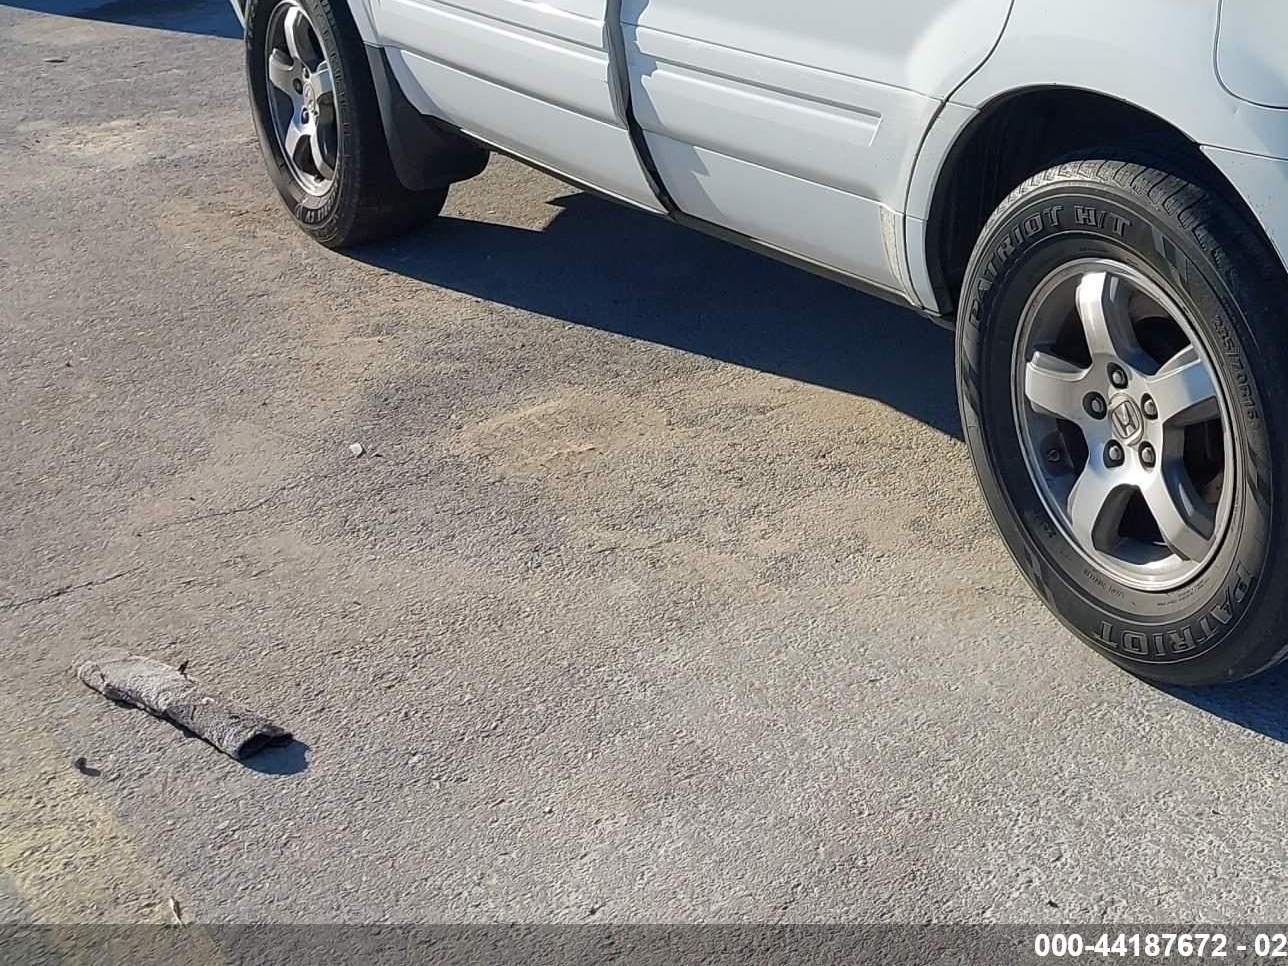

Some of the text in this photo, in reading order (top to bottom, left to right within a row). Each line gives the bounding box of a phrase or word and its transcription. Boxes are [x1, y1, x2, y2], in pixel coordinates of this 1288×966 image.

[968, 204, 1133, 331] PATRIOT H/T
[1091, 560, 1253, 658] PATRIOT
